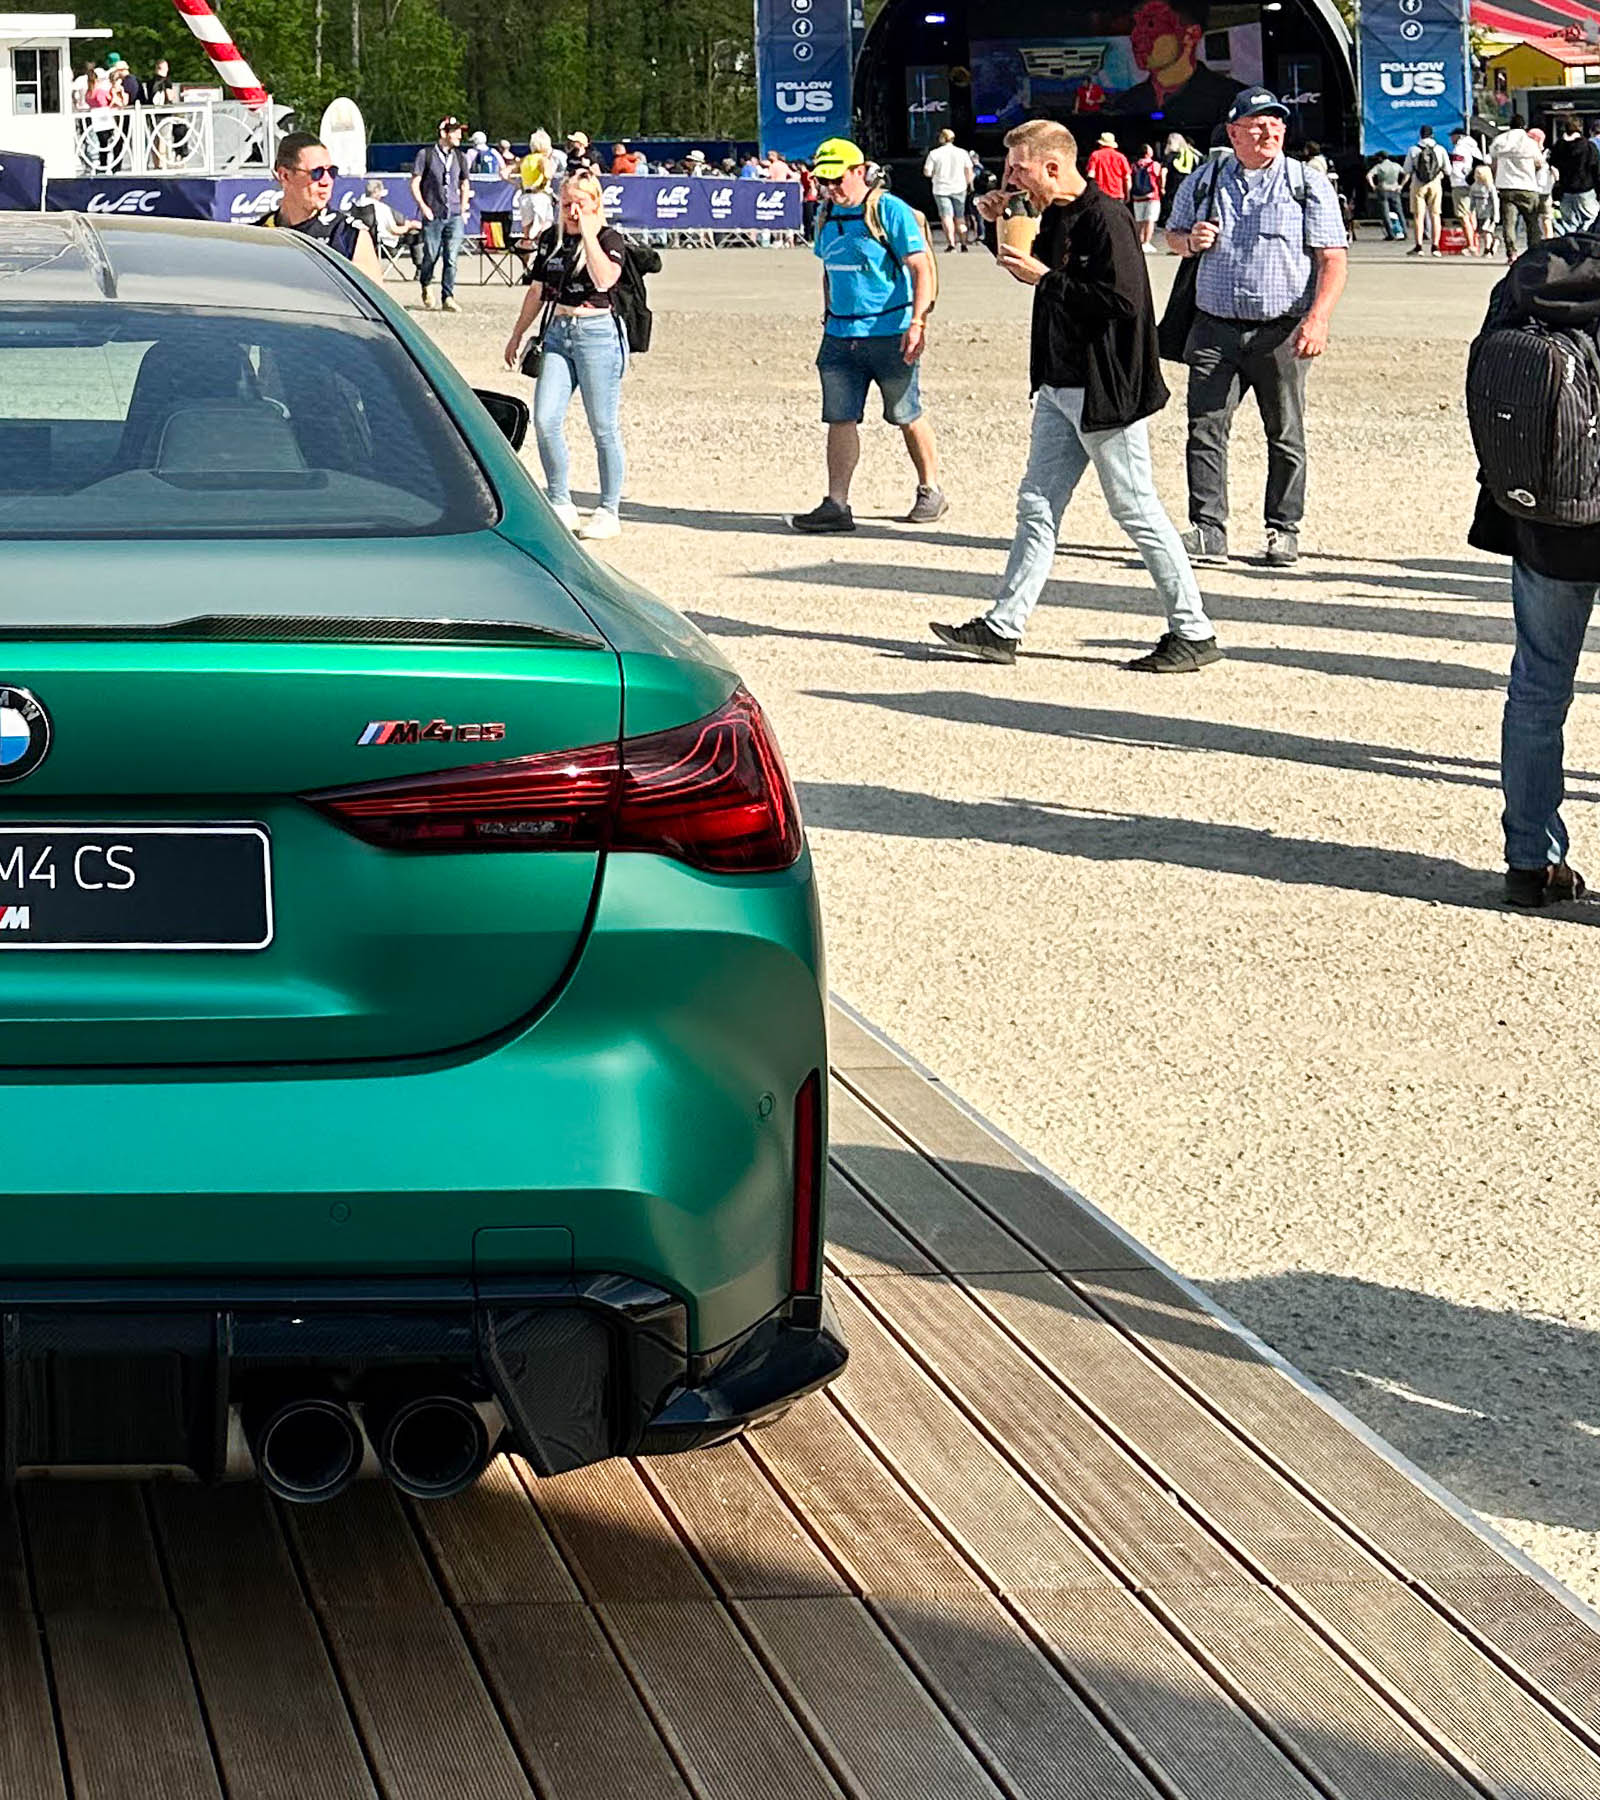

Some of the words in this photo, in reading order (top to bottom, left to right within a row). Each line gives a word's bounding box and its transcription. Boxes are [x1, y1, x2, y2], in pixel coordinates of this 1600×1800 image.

[1380, 62, 1445, 72] FOLLOW
[776, 81, 832, 90] FOLLOW
[1380, 72, 1446, 96] US
[776, 91, 834, 113] US
[87, 190, 161, 213] WEC
[657, 186, 690, 205] WEC
[757, 190, 786, 209] WEC
[74, 845, 135, 890] CS
